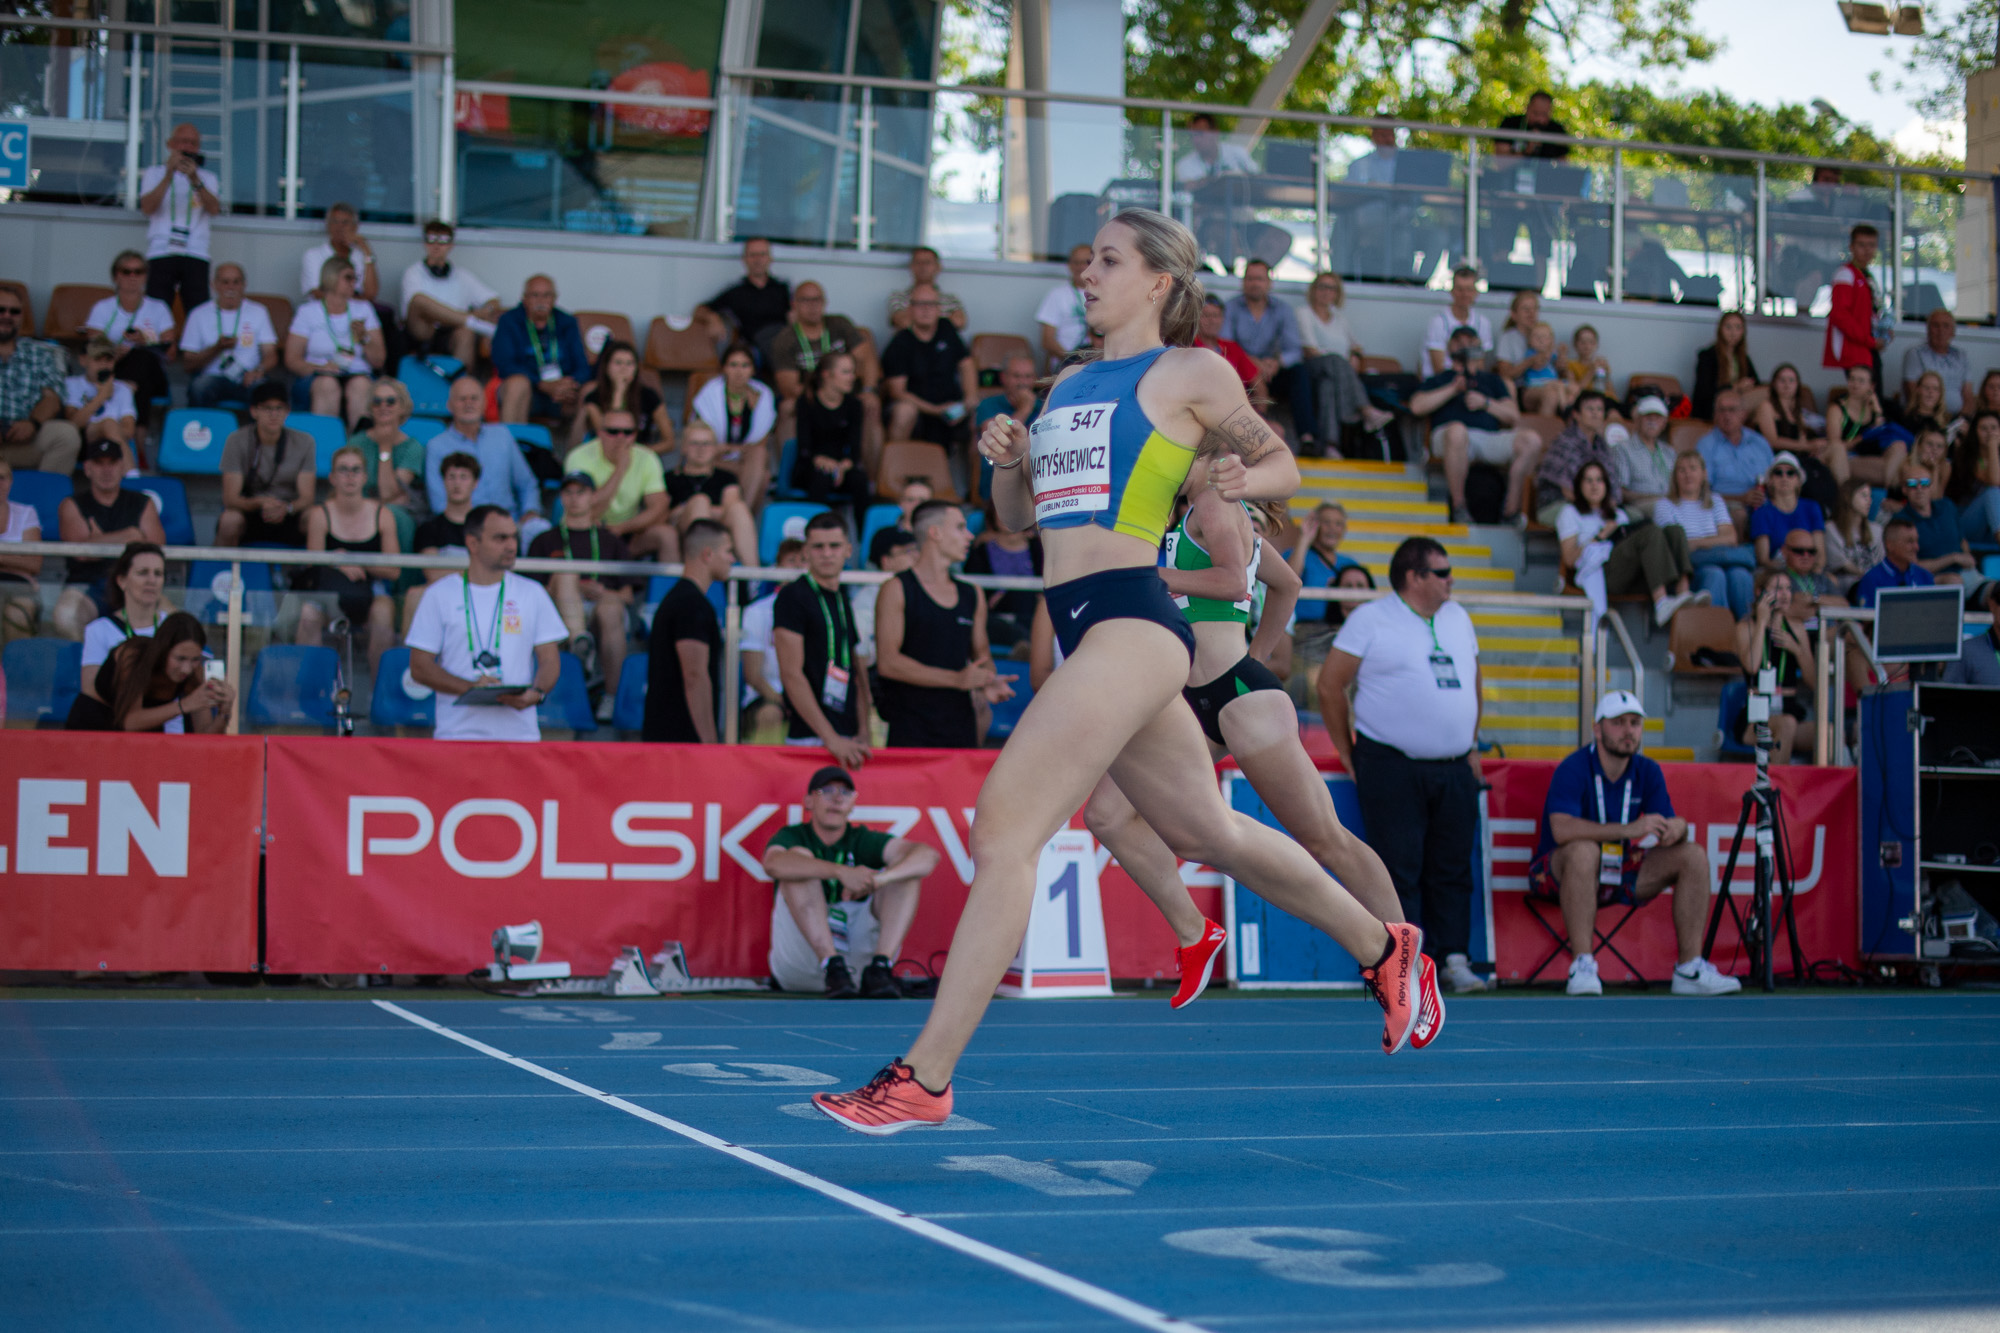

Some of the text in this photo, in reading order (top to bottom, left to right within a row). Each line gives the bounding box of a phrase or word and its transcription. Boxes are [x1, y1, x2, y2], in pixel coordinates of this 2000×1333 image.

[0, 130, 24, 161] C
[1070, 409, 1106, 432] 547
[1030, 446, 1106, 480] MATYŚKIEWICZ
[1041, 498, 1079, 513] LUBLIN 2023
[1071, 486, 1088, 495] Polski
[1087, 485, 1102, 493] U20
[0, 777, 190, 877] EN
[347, 795, 803, 882] POLSK
[1048, 860, 1082, 959] 1
[1398, 928, 1410, 1007] new balance
[935, 1154, 1157, 1196] 4
[1160, 1226, 1505, 1288] 3
